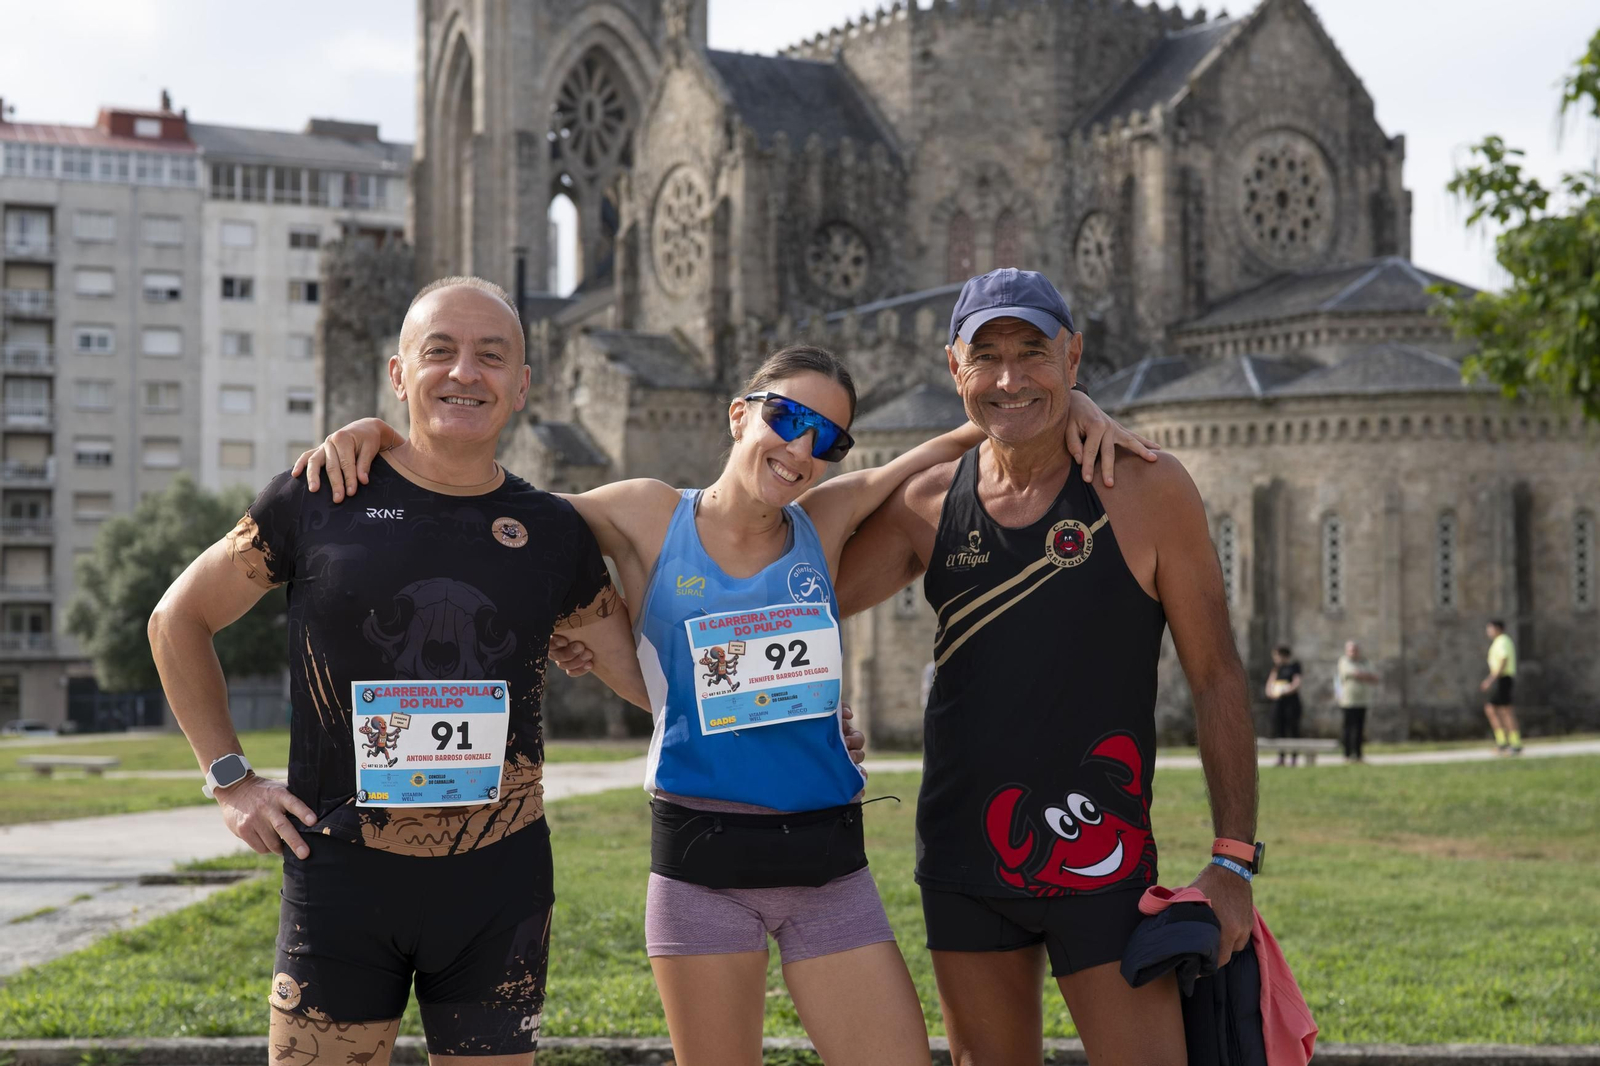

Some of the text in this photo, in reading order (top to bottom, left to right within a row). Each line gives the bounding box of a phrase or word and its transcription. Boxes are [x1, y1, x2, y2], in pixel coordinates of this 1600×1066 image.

[946, 551, 990, 568] El Trigal
[1046, 538, 1093, 567] MARISQUEIRO
[676, 588, 705, 598] SURAL
[699, 608, 820, 631] II CARREIRA POPULAR
[734, 619, 793, 637] DO PULPO
[765, 639, 810, 671] 92
[749, 666, 829, 685] JENNIFER BARROSO DELGADO
[374, 686, 438, 698] CARREIRA
[400, 698, 464, 709] DO PULPO
[709, 715, 737, 727] GADIS
[431, 721, 473, 750] 91
[406, 753, 492, 762] ANTONIO BARROSO GONZALEZ
